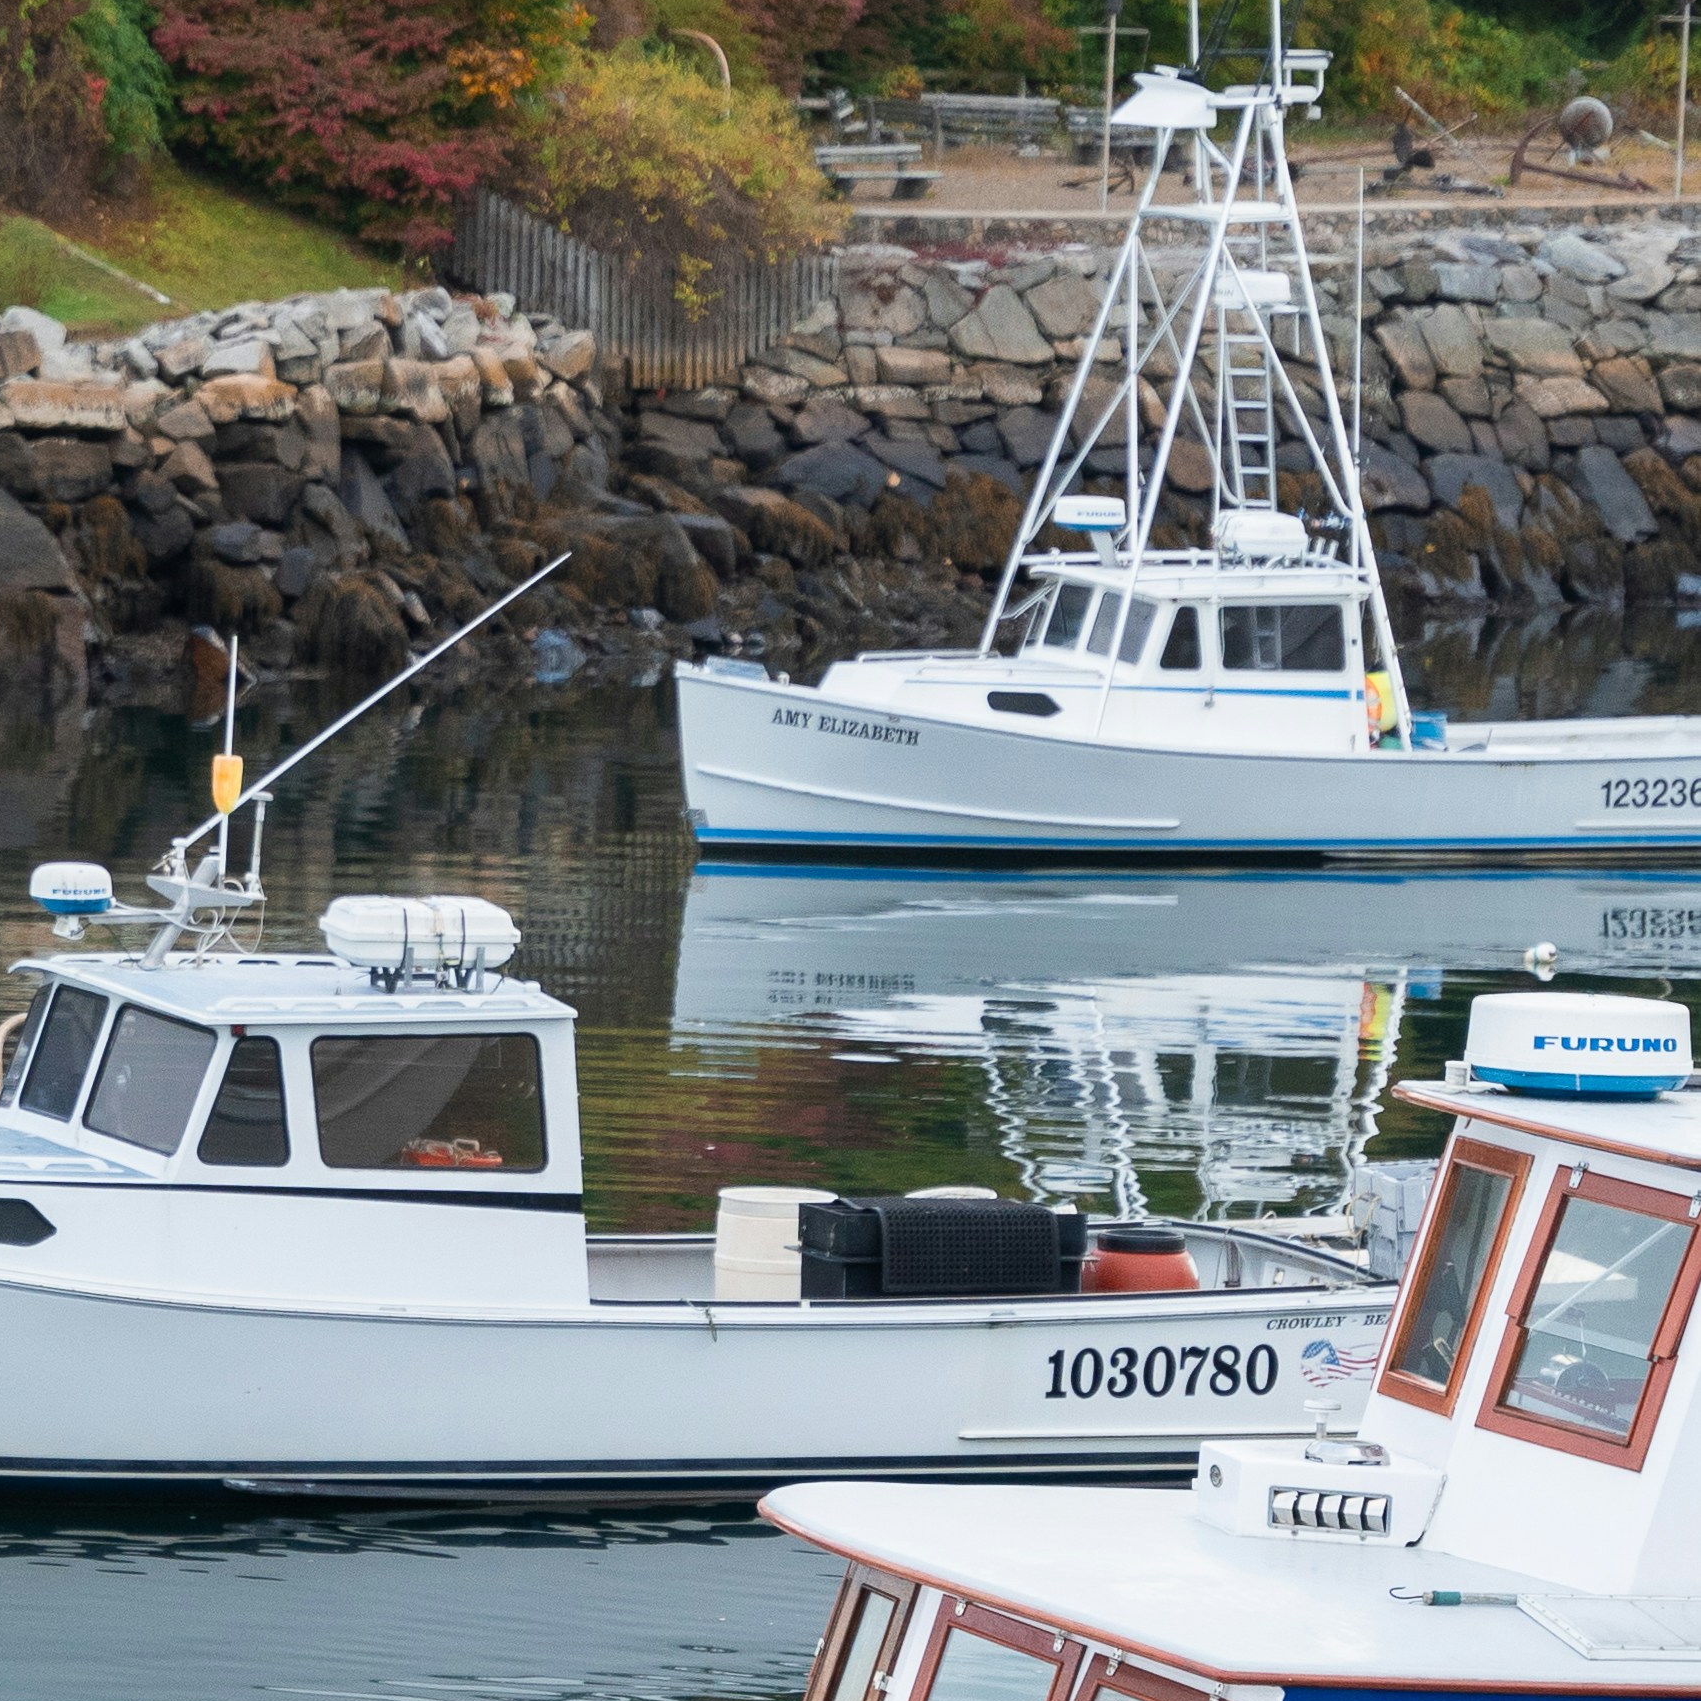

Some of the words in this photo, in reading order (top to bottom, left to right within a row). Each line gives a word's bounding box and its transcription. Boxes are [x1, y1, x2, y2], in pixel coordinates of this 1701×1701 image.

[771, 708, 813, 729] AMY
[818, 715, 921, 746] ELIZABETH
[1601, 778, 1701, 808] 123236
[1533, 1035, 1678, 1053] FURUNO
[1266, 1316, 1347, 1330] CROWLEY
[1045, 1343, 1279, 1399] 1030780
